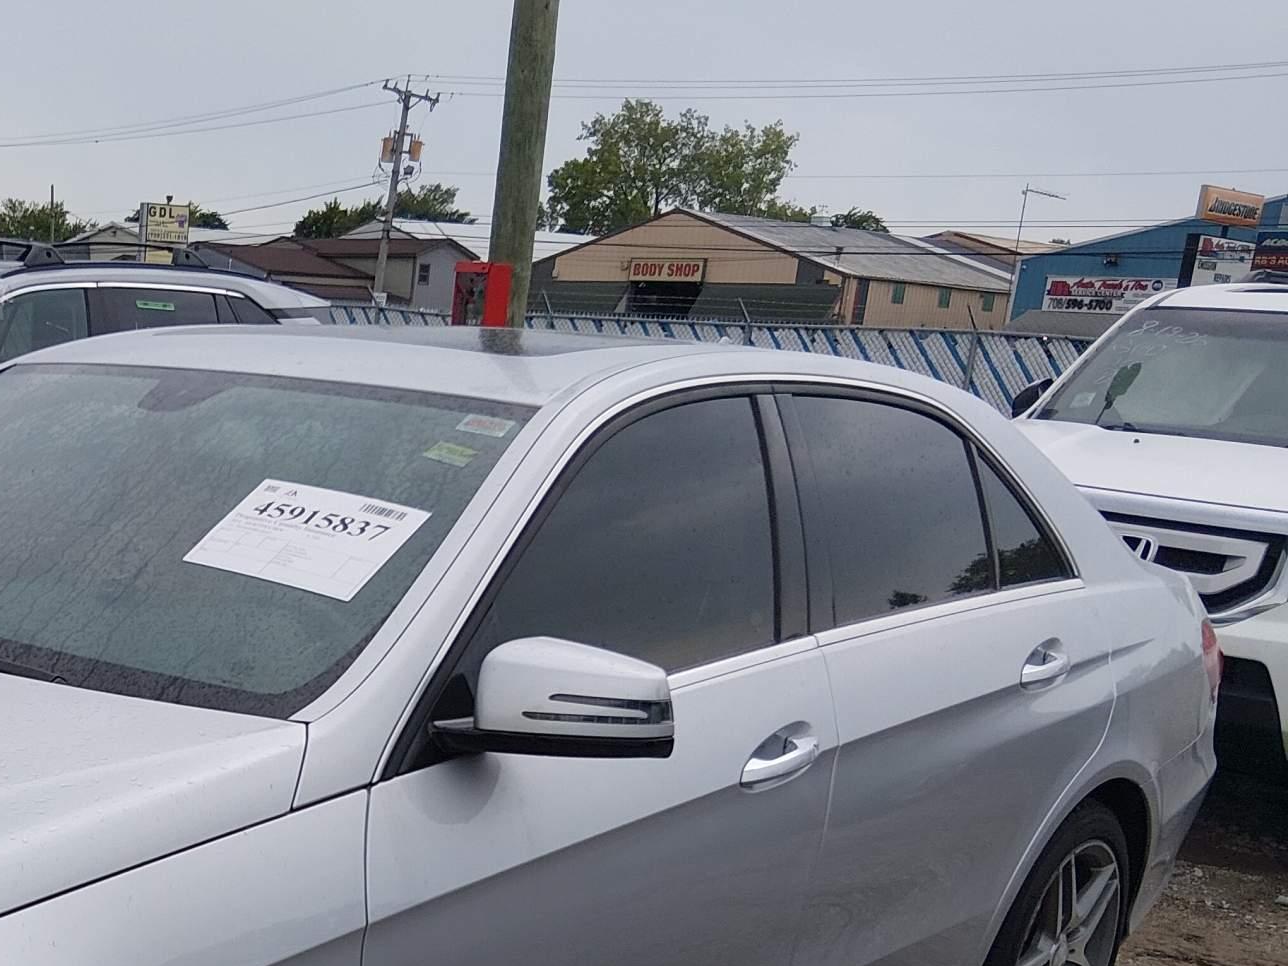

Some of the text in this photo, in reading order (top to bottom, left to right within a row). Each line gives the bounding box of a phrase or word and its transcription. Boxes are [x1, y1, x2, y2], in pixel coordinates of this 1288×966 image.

[148, 206, 175, 219] GDL
[632, 262, 700, 277] BODY SHOP
[254, 501, 391, 541] 45915837
